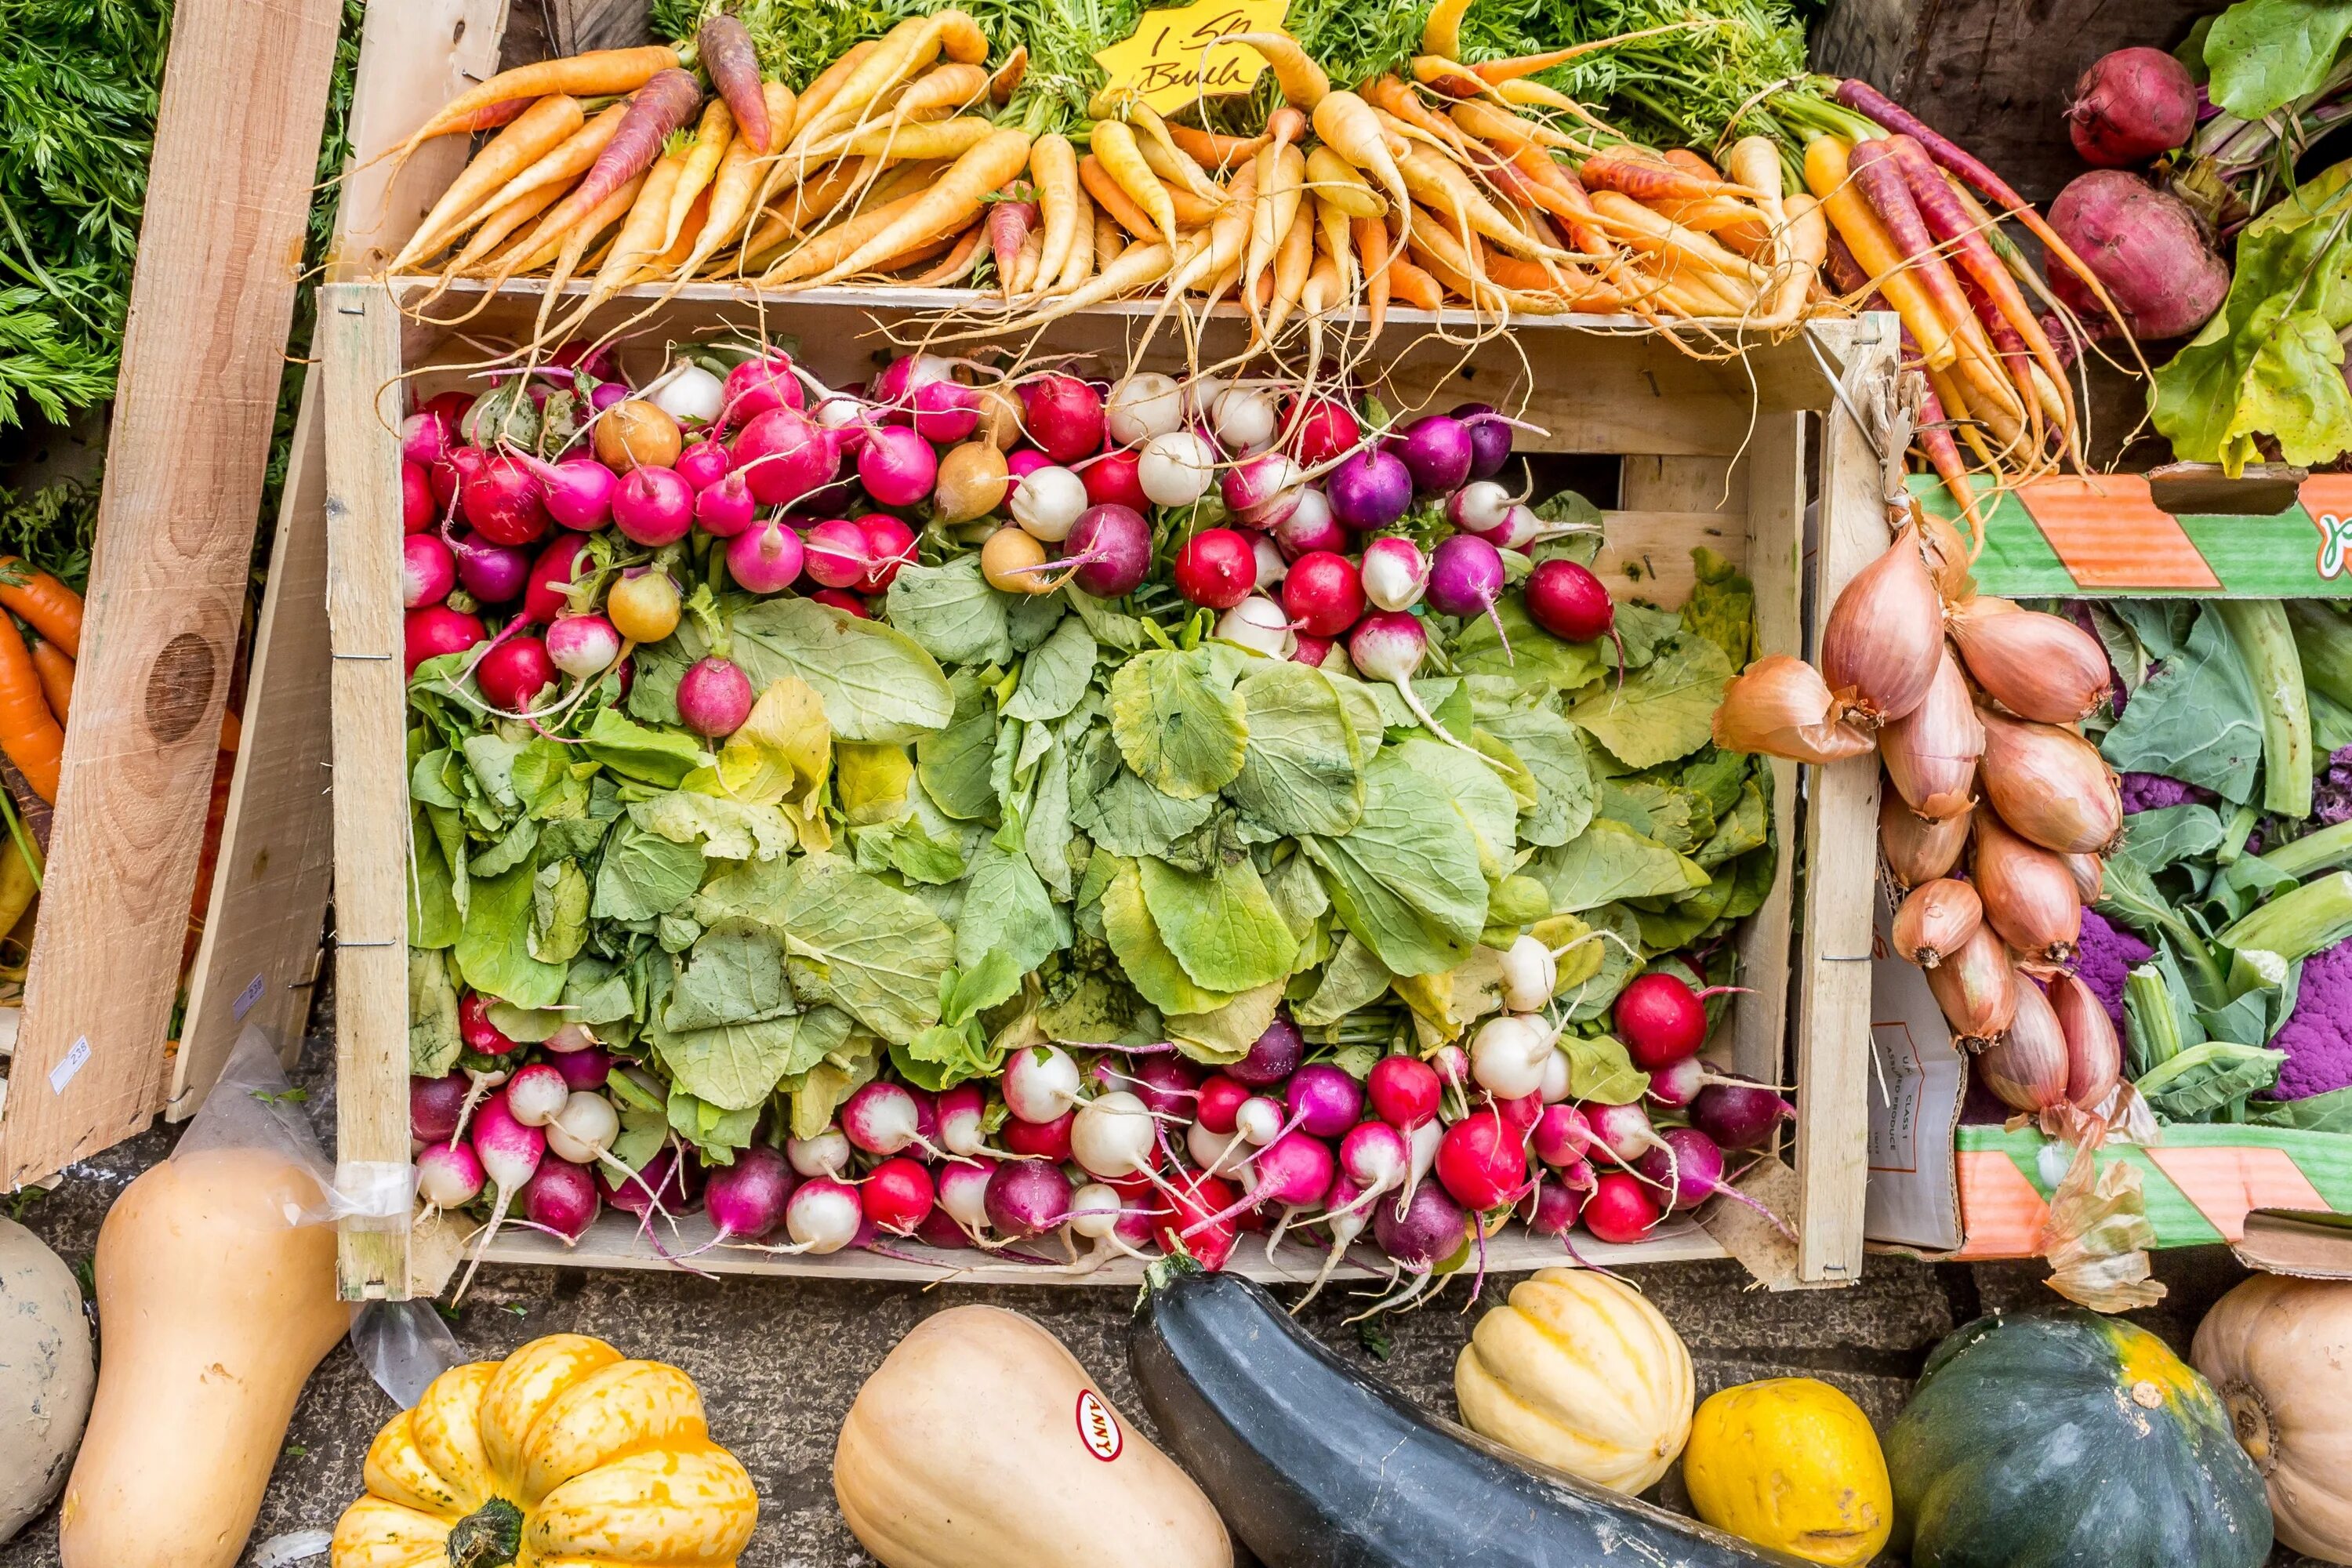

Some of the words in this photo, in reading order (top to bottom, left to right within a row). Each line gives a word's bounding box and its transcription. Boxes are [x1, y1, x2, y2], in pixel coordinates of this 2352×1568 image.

[1137, 56, 1254, 94] Bunch
[71, 1042, 87, 1065] 238
[1889, 1096, 1899, 1151] PRODUCE
[1903, 1094, 1912, 1131] CLASS
[1087, 1395, 1112, 1454] ANNY
